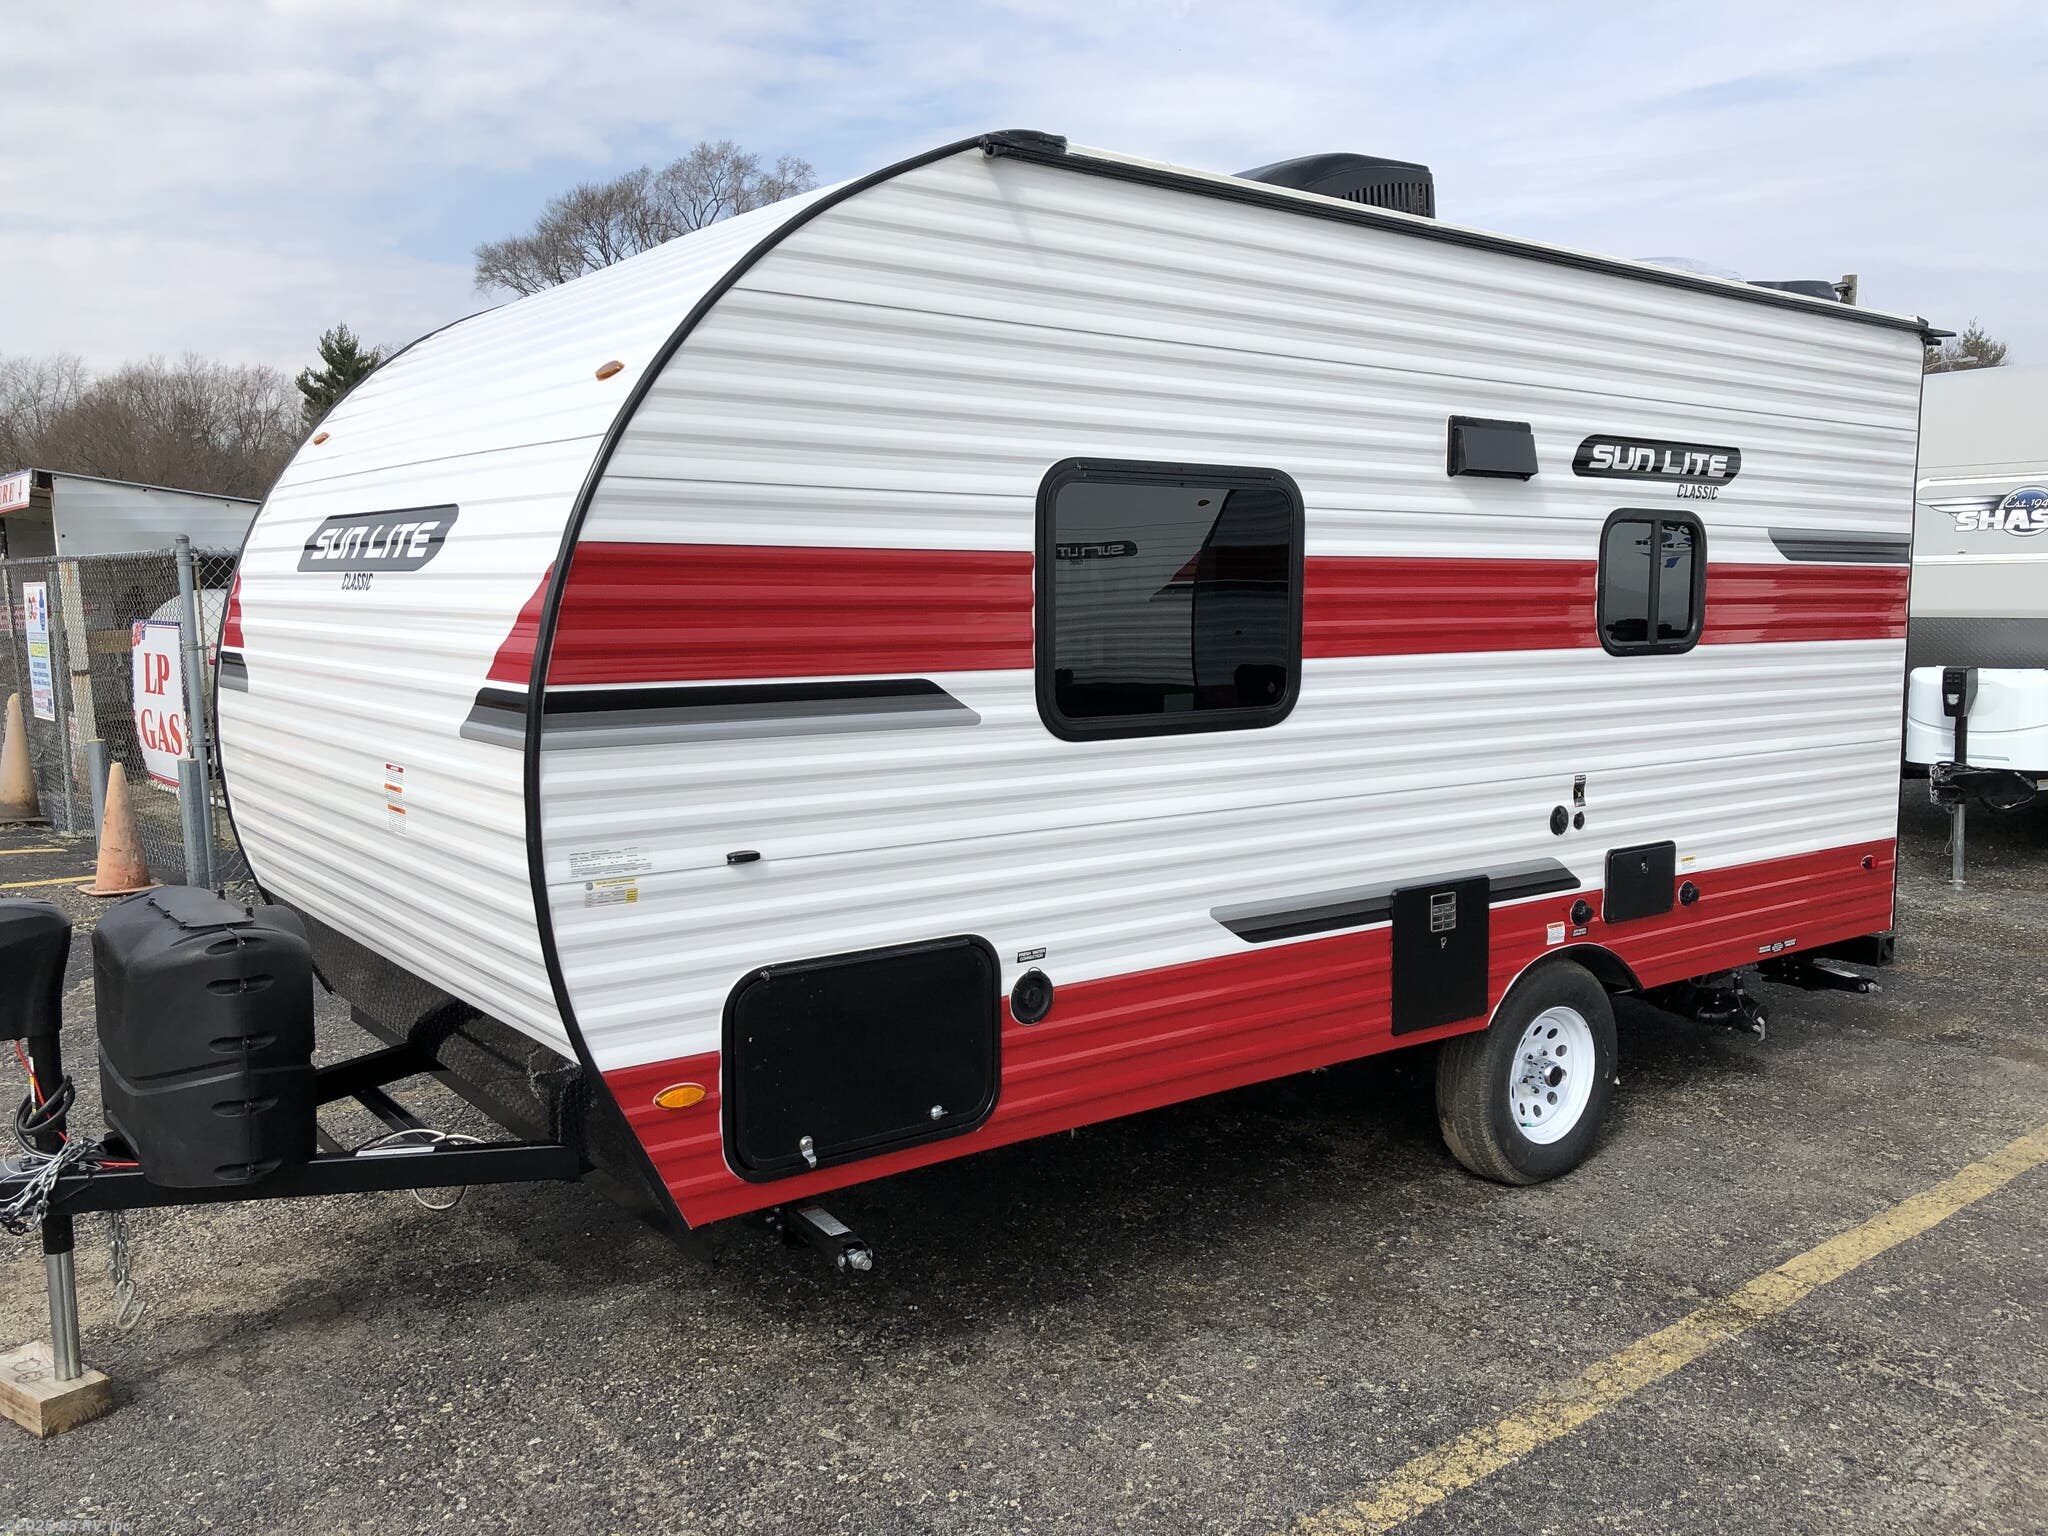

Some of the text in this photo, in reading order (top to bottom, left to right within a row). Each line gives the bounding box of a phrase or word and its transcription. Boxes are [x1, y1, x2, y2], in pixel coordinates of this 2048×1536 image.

[1589, 445, 1728, 477] SUN LITE
[1676, 484, 1719, 500] CLASSIC
[311, 521, 440, 559] SUN LITE
[341, 573, 373, 591] CLASSIC
[144, 652, 170, 696] LP
[141, 709, 182, 756] GAS
